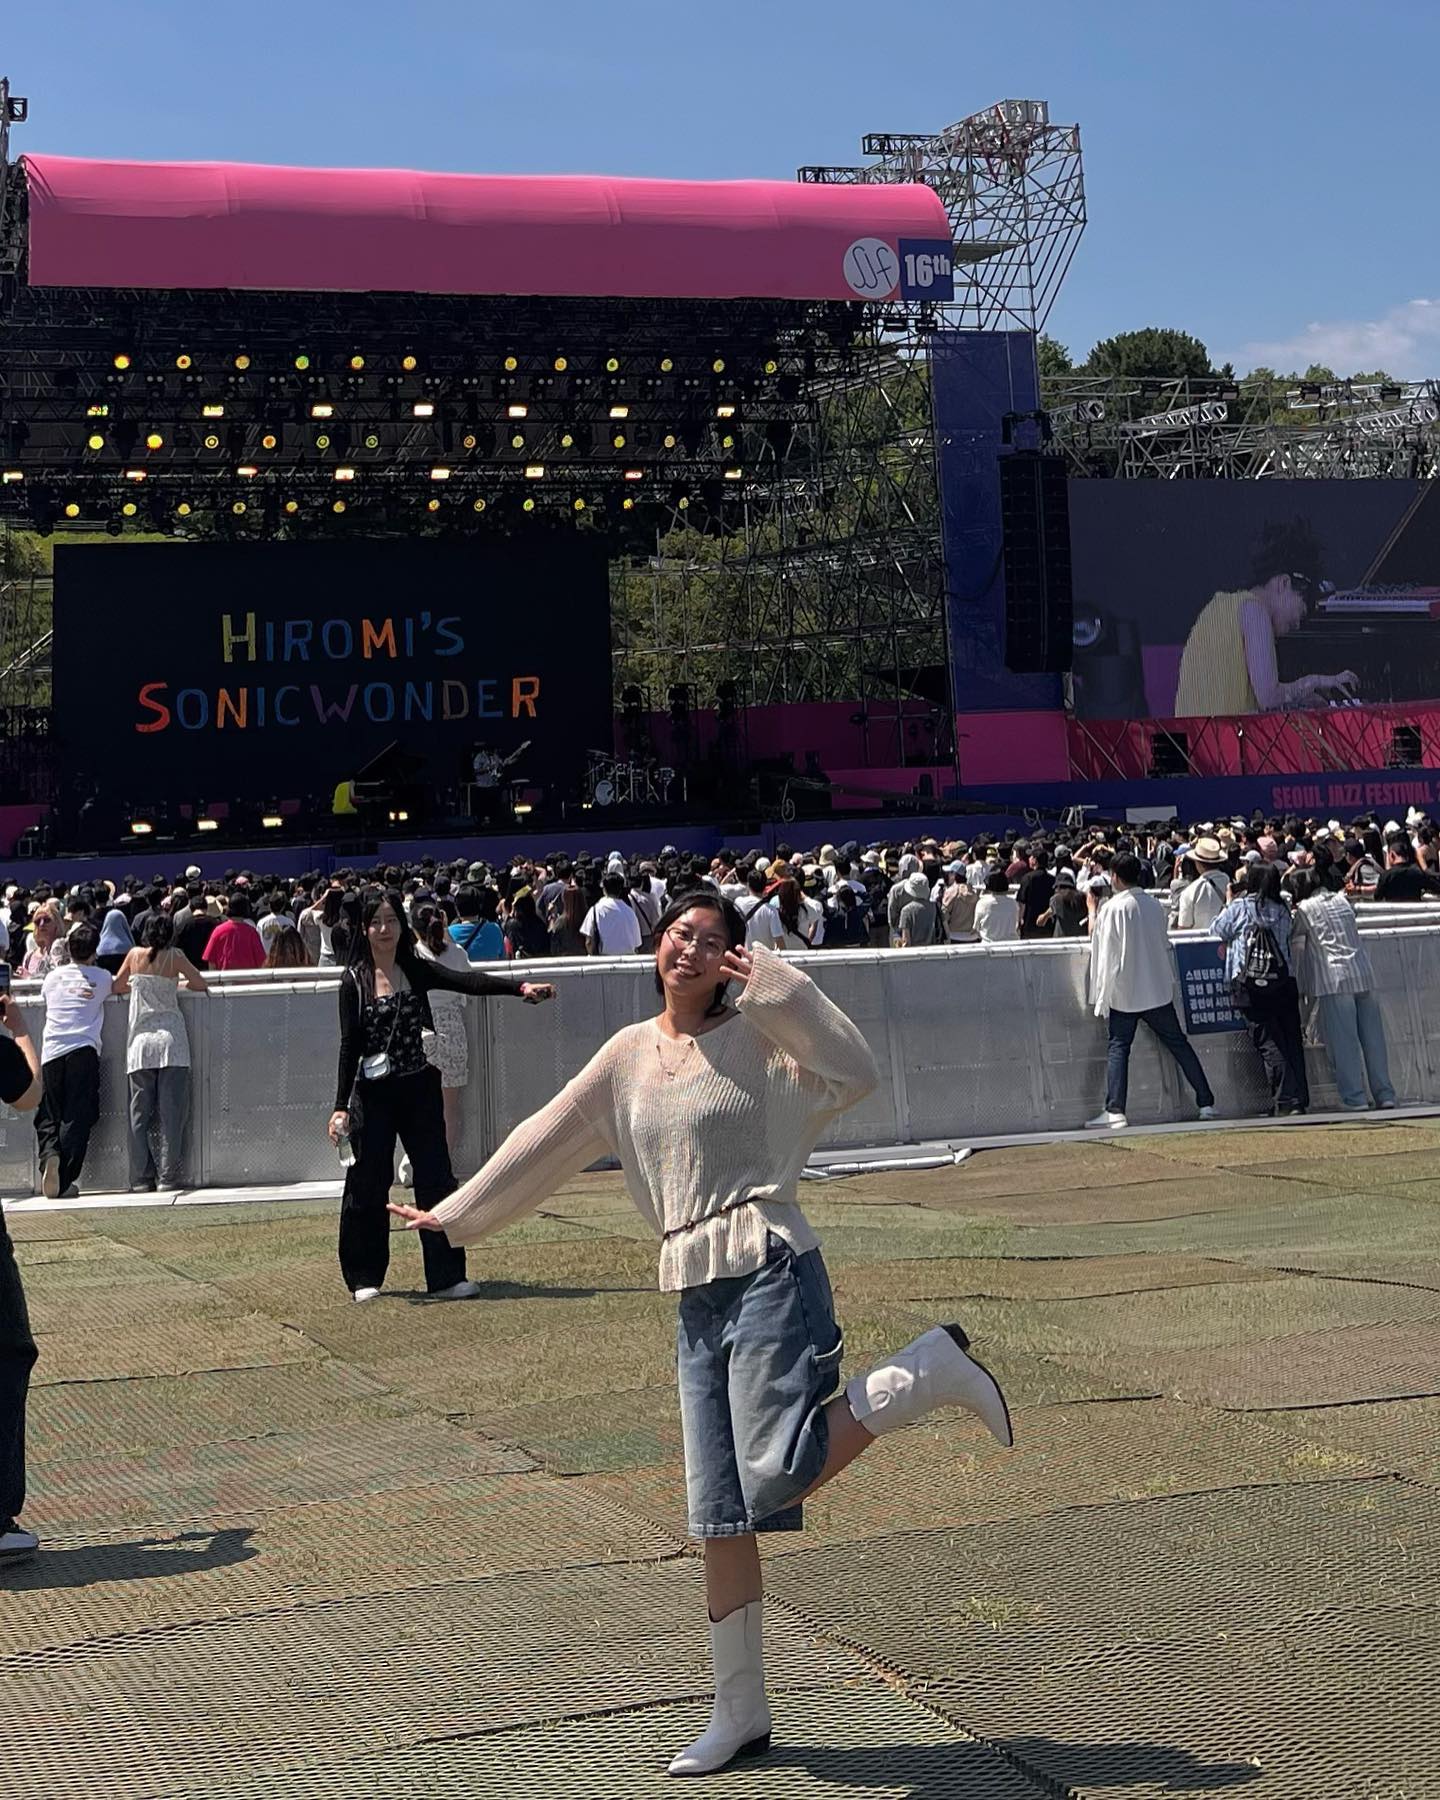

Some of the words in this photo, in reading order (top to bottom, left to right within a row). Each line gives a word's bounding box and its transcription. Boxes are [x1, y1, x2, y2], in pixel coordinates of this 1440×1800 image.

[904, 253, 951, 288] 16th
[222, 611, 465, 663] HIROMI'S
[135, 676, 540, 733] SONICWONDER
[1272, 785, 1324, 809] SEOUL
[1328, 784, 1362, 807] JAZZ
[1365, 781, 1434, 806] FESTIVAL
[1191, 1011, 1215, 1024] 안내에
[1216, 1010, 1232, 1022] 따라
